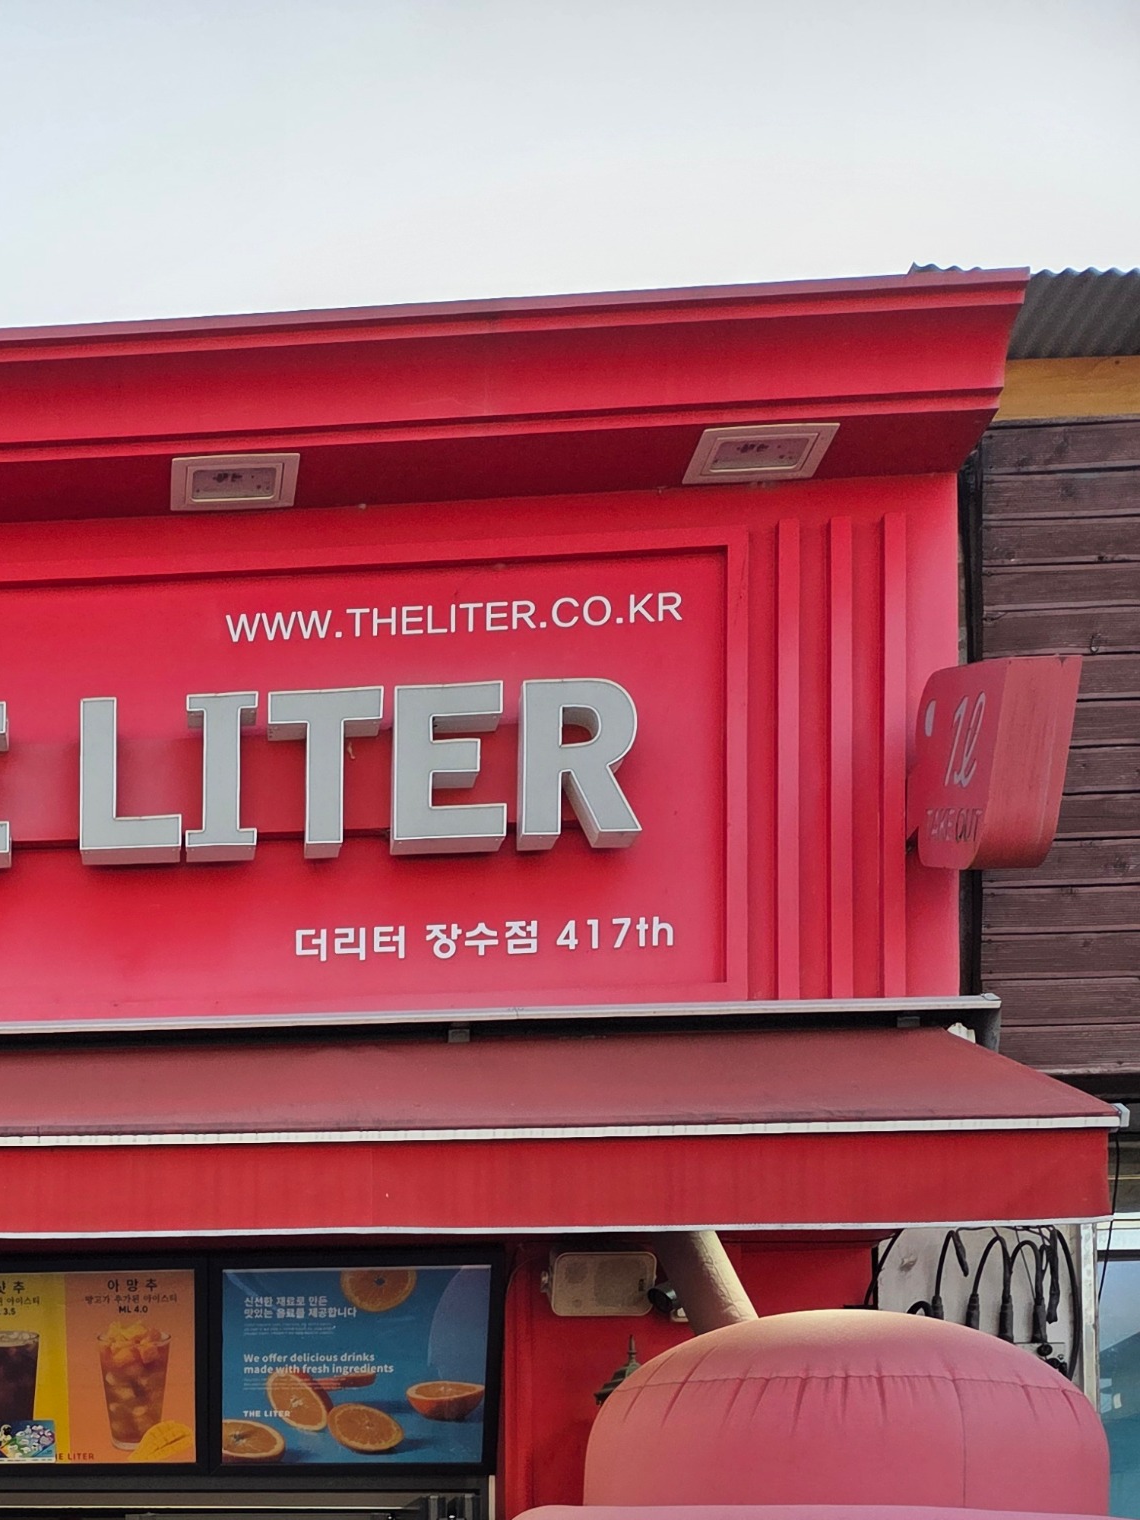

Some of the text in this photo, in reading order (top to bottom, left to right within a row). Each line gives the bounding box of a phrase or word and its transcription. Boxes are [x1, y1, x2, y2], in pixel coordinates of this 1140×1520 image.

[225, 592, 683, 643] WWW.THELITER.CO.KR
[79, 678, 642, 865] LITER
[295, 916, 674, 961] 더리터 장수점 417th
[244, 1296, 273, 1307] 신선한
[276, 1296, 306, 1307] 재료로
[2, 1307, 17, 1316] 3.5
[118, 1305, 149, 1315] ML 4.0
[243, 1306, 357, 1319] 맛있는 음료를 제공합니다
[243, 1352, 376, 1363] We offer delicious drinks
[243, 1363, 394, 1376] made with fresh ingredients
[243, 1410, 291, 1418] THE LITER
[67, 1452, 95, 1461] LITER
